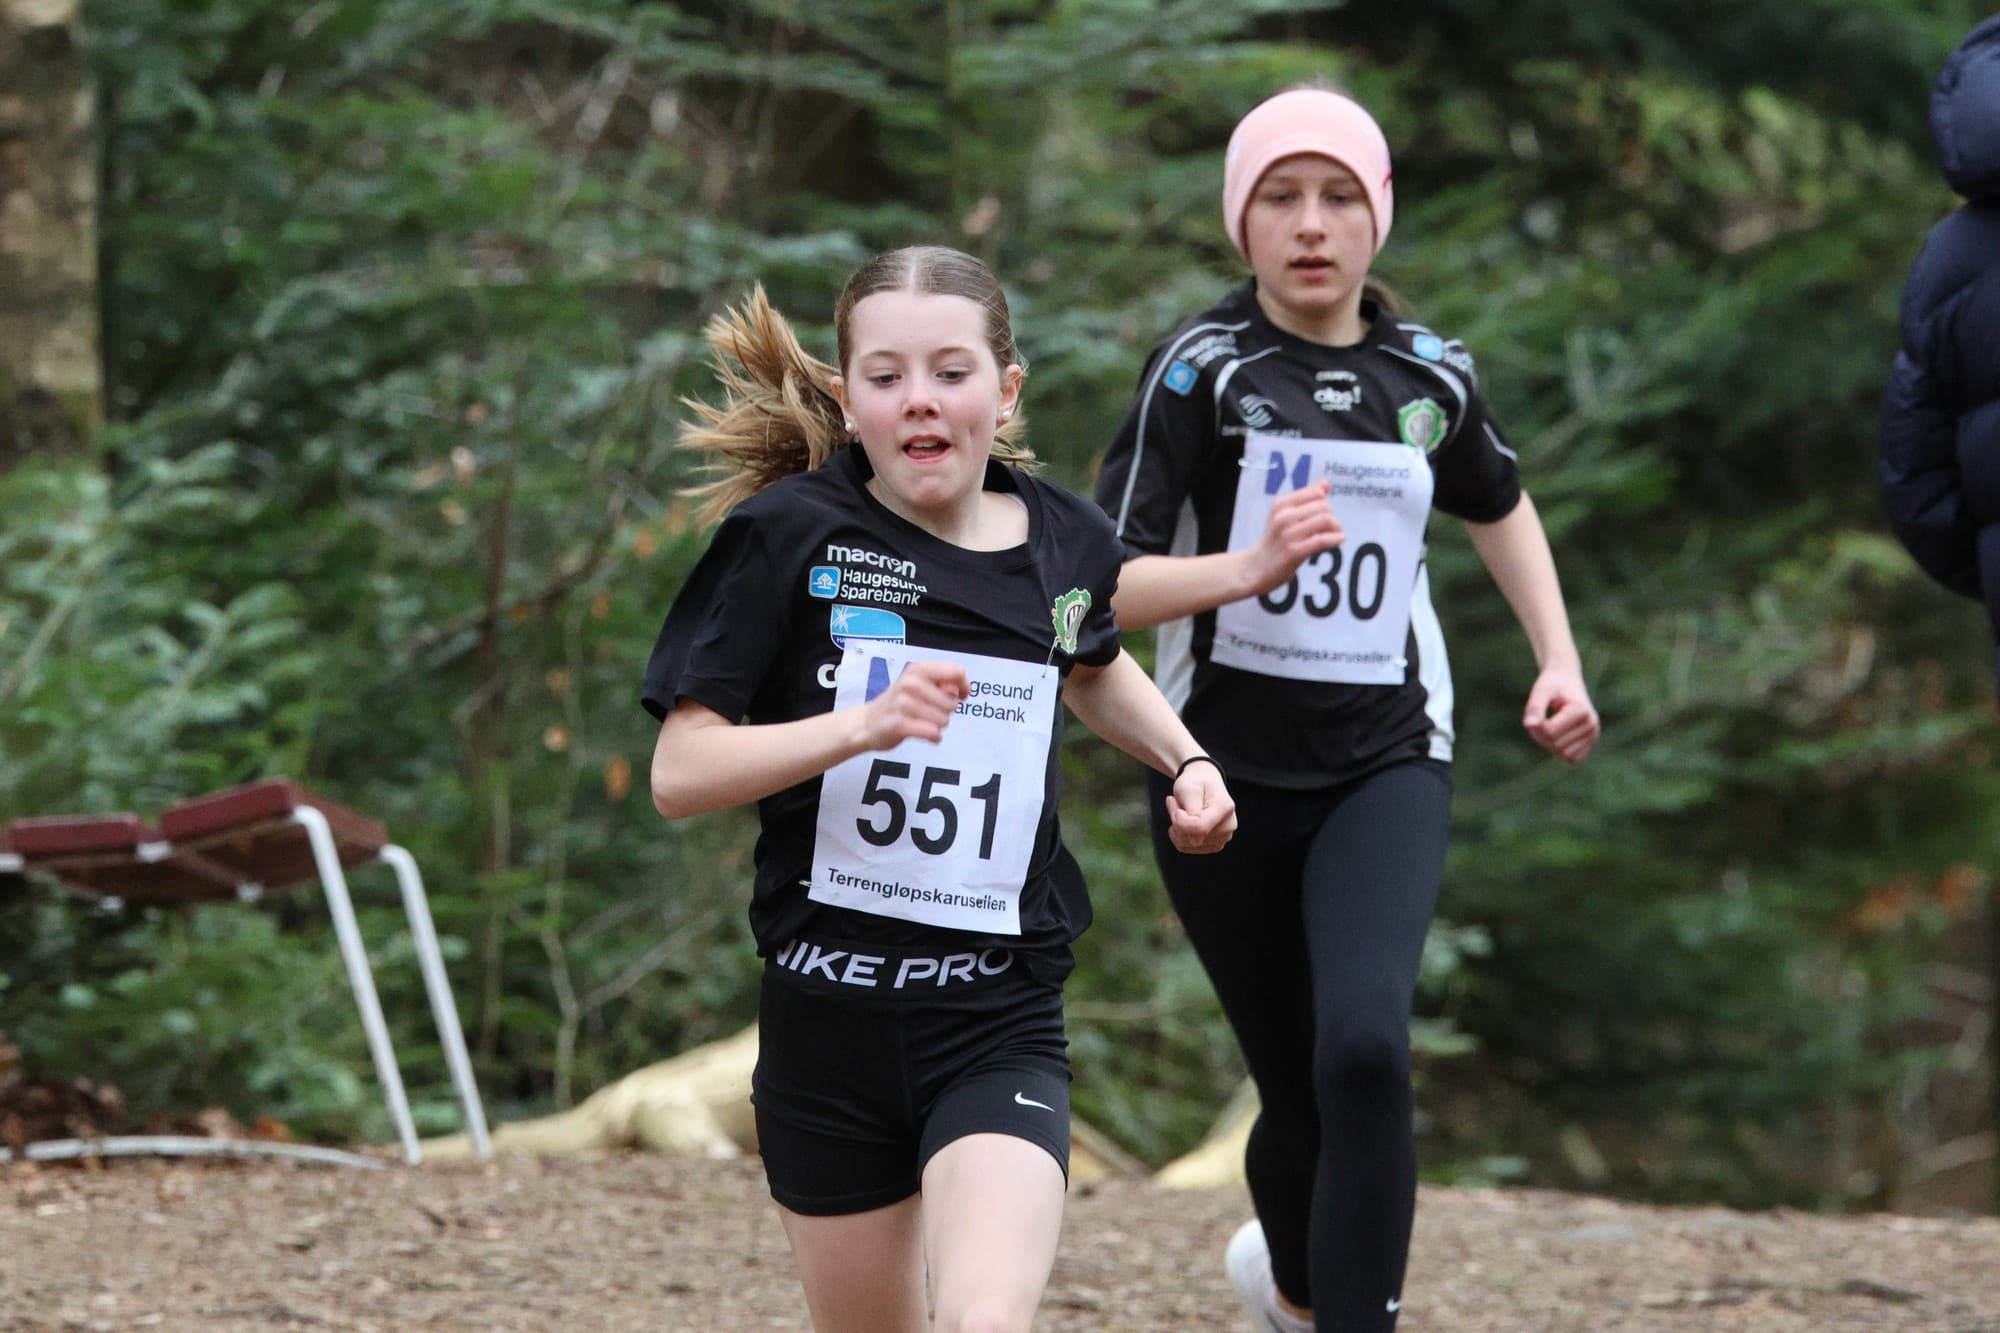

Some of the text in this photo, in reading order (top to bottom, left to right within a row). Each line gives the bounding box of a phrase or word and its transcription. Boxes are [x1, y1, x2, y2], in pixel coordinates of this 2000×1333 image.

[827, 544, 916, 579] macron
[840, 584, 921, 607] Sparebank
[969, 680, 1034, 701] gesund
[954, 701, 1026, 723] arebank
[856, 758, 1002, 860] 551
[893, 948, 1014, 989] PRO
